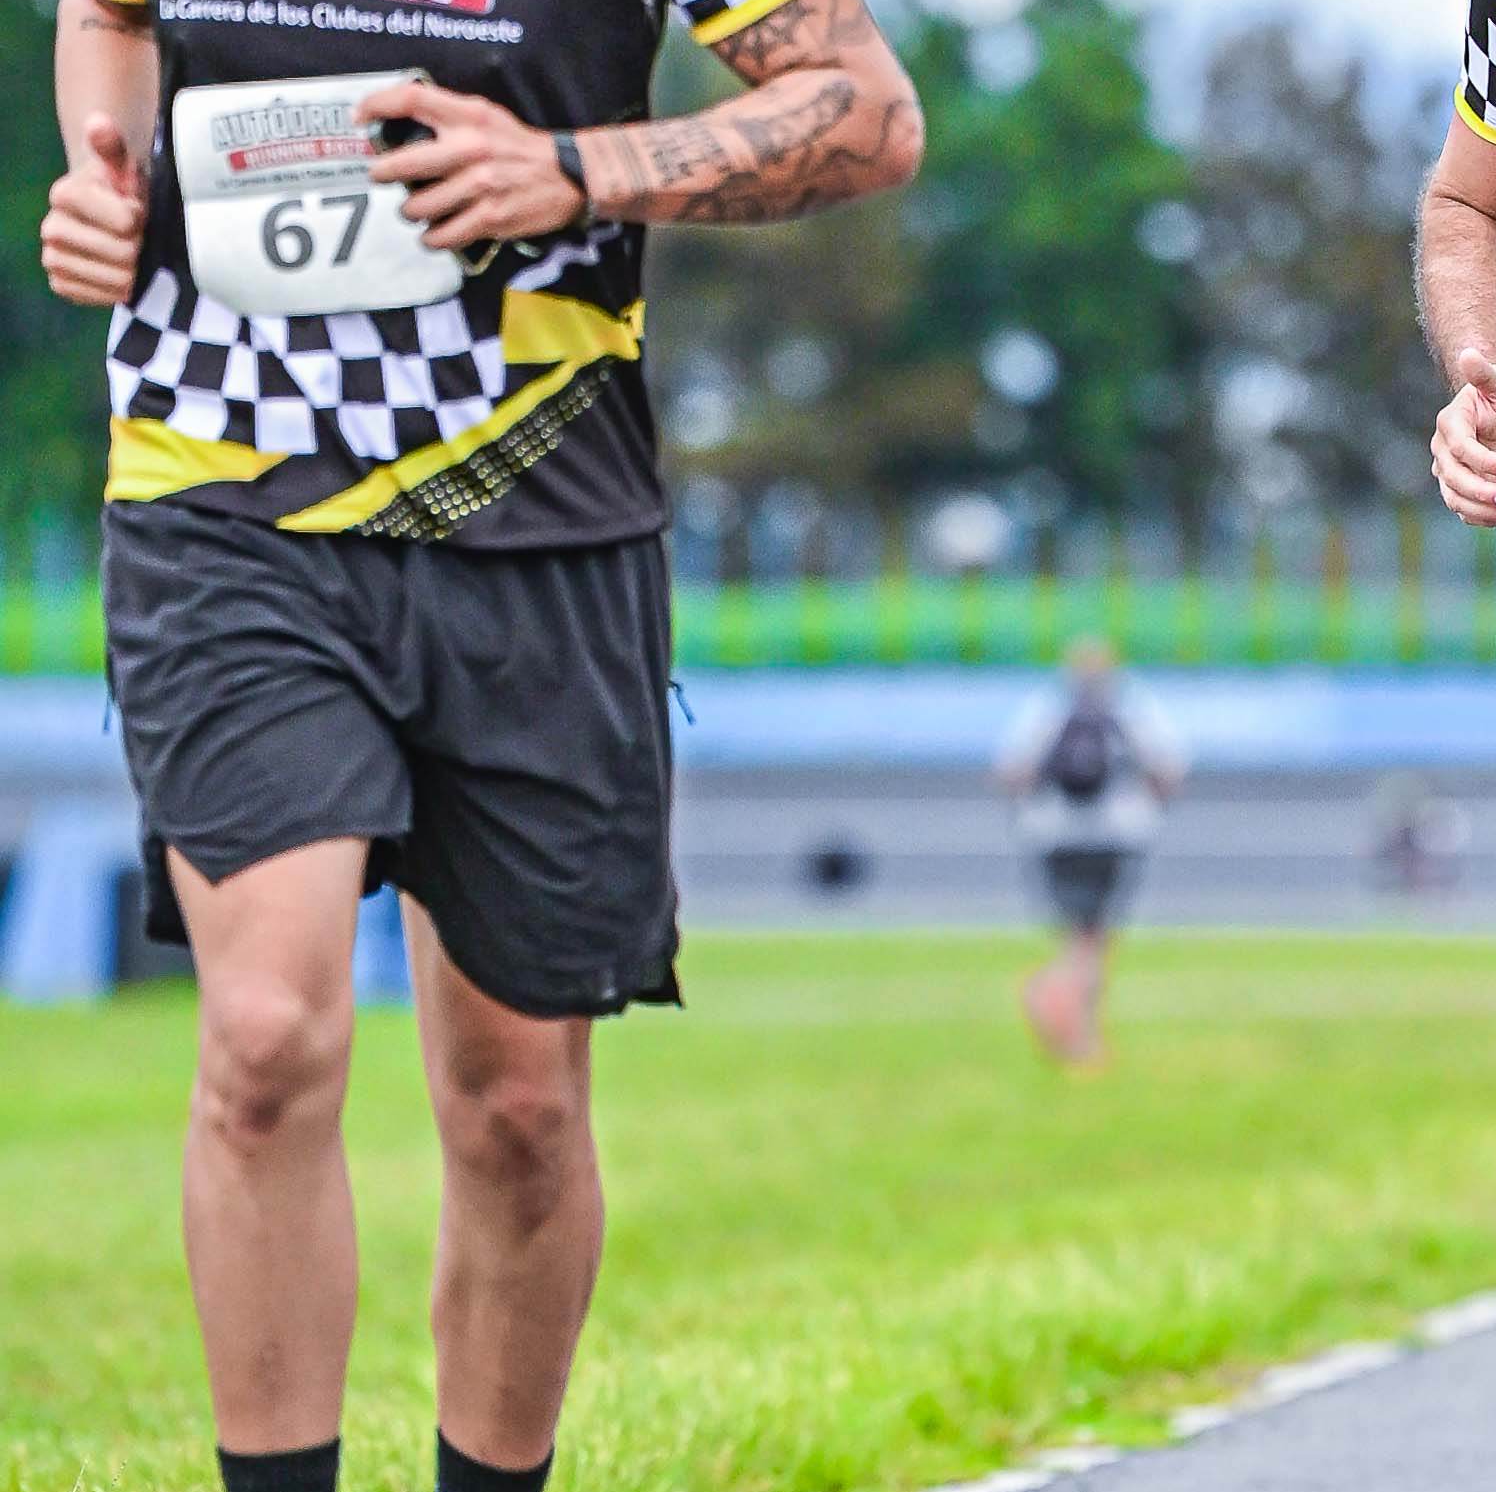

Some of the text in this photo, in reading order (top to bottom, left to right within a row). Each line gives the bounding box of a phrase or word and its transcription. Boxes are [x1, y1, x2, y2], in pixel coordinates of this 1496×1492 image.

[311, 2, 386, 33] Clubes
[386, 9, 423, 36] del
[423, 11, 524, 43] Noroeste
[261, 192, 369, 269] 67
